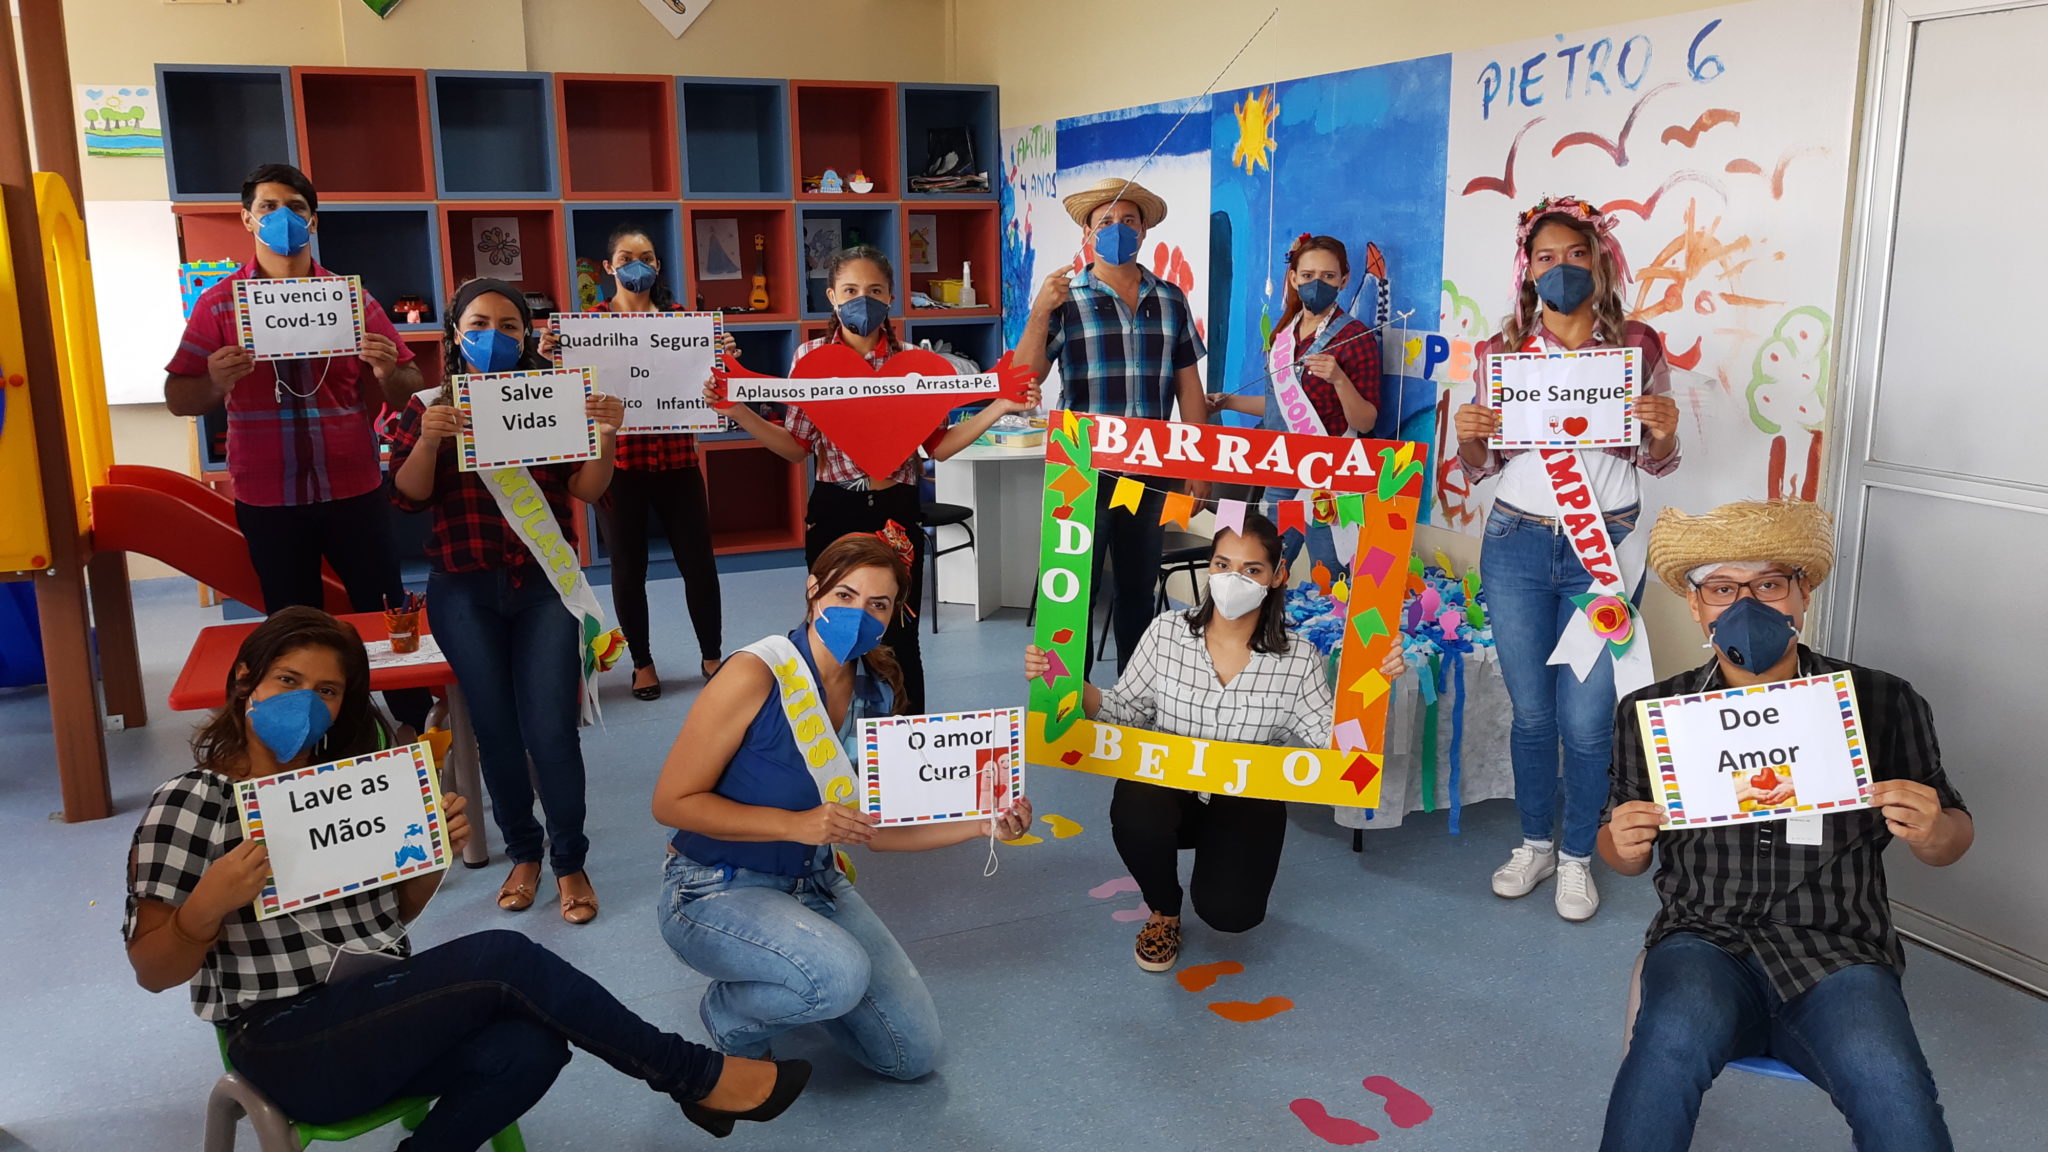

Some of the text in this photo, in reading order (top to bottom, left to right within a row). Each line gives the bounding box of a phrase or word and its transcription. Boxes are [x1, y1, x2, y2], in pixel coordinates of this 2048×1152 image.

[1477, 18, 1726, 120] PIETRO 6
[1020, 172, 1057, 200] 4 ANOS
[253, 287, 343, 305] Eu venci o
[265, 312, 337, 328] Covd-19
[558, 333, 710, 351] Quadrilha Segura
[1273, 324, 1292, 384] MISS
[1424, 334, 1484, 382] PE
[630, 366, 650, 378] Do
[501, 383, 553, 402] Salve
[736, 375, 997, 399] Aplausos para o nosso Arrasta-Pé.
[1500, 384, 1625, 404] Doe Sangue
[620, 396, 708, 410] ico Infanti
[502, 412, 557, 431] Vidas
[1091, 416, 1376, 490] BARRACA
[493, 467, 577, 597] MULATA
[1042, 518, 1092, 603] DO
[773, 657, 838, 769] MISS
[1719, 706, 1780, 731] Doe
[908, 729, 993, 750] O amor
[1088, 723, 1322, 794] BEIJO
[1718, 745, 1800, 773] Amor
[919, 763, 971, 782] Cura
[289, 773, 389, 813] Lave as
[309, 816, 386, 850] Mãos
